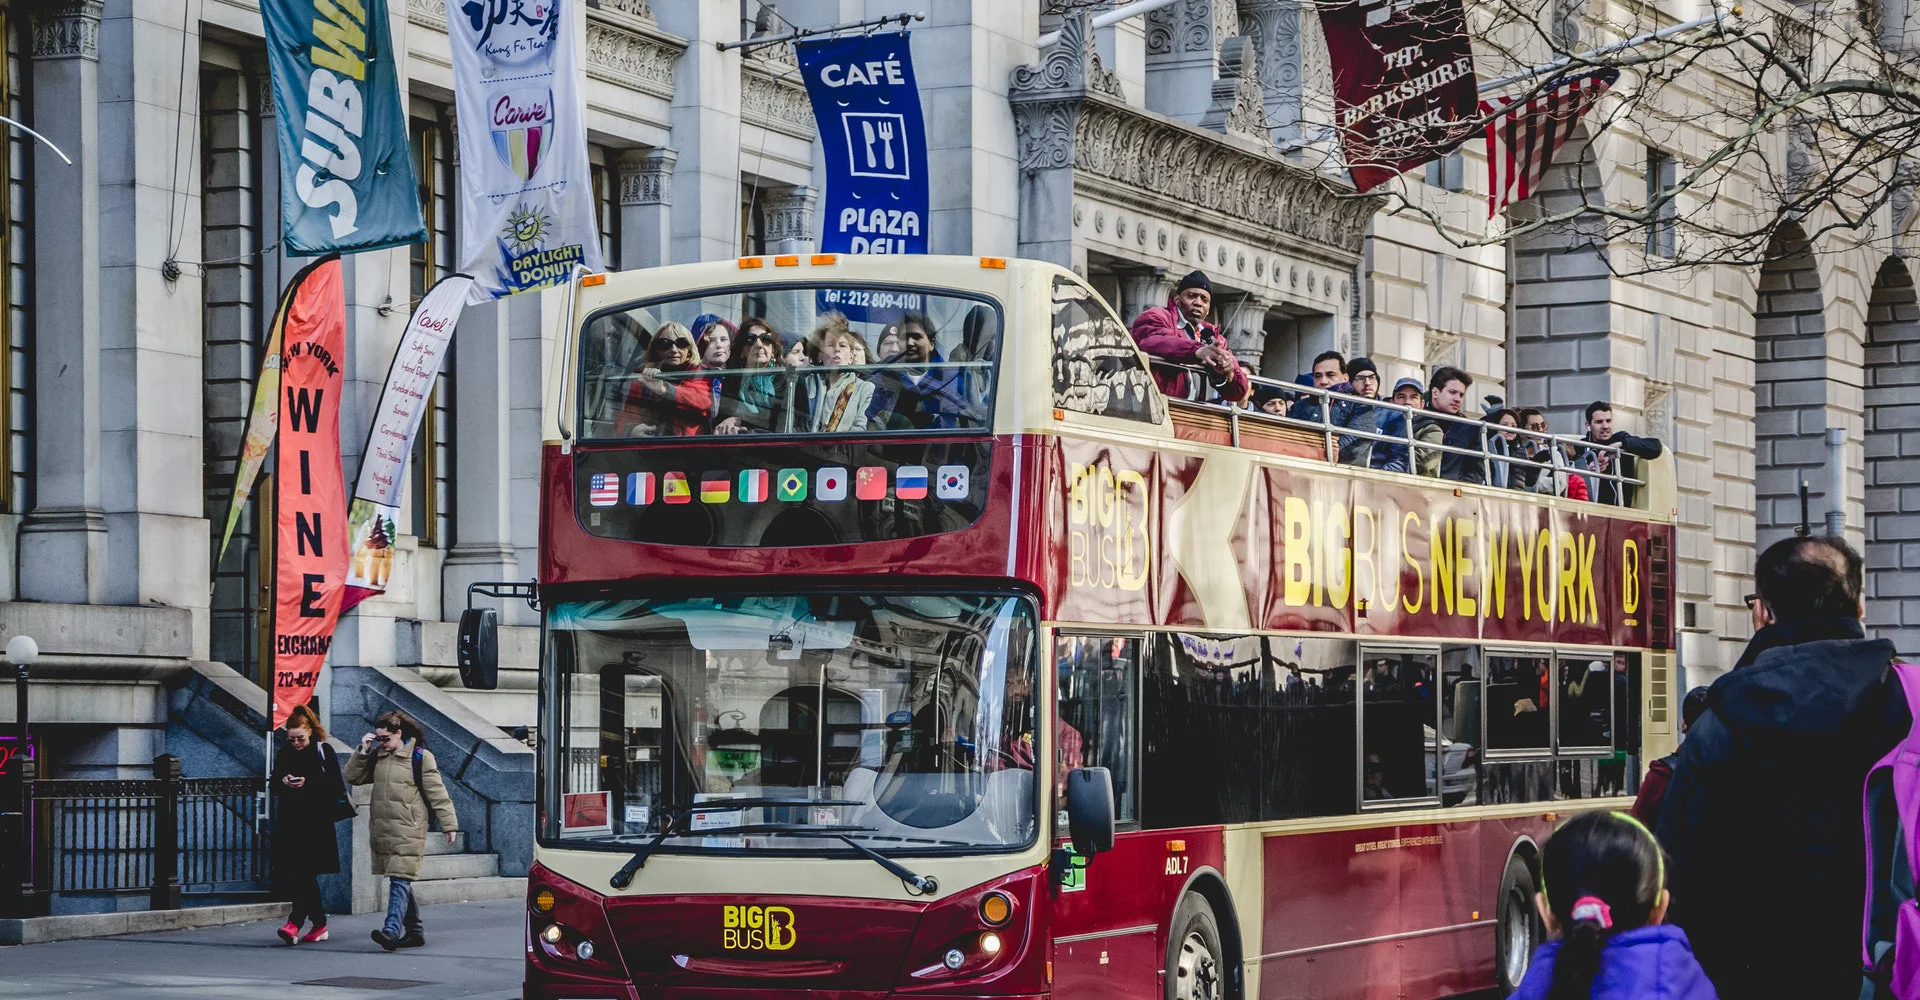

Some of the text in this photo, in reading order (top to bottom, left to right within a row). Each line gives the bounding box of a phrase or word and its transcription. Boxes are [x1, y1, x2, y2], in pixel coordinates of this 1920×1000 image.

[485, 38, 546, 57] Kung Fu Tea
[820, 53, 905, 88] CAFÉ
[1345, 57, 1473, 127] BERKSHIRE
[295, 0, 366, 240] SUBW
[494, 95, 548, 126] Carvel
[1377, 107, 1446, 145] BANK
[839, 207, 920, 236] PLAZA
[513, 245, 581, 271] DAYLIGHT
[305, 342, 340, 378] YORK
[286, 386, 326, 618] WINE
[1071, 462, 1115, 528] BIG
[1071, 531, 1115, 590] BUS
[1430, 516, 1508, 619] NEW
[1517, 527, 1598, 625] YORK
[1165, 856, 1189, 875] ADL 7
[724, 905, 764, 928] BIG
[724, 929, 764, 950] BUS
